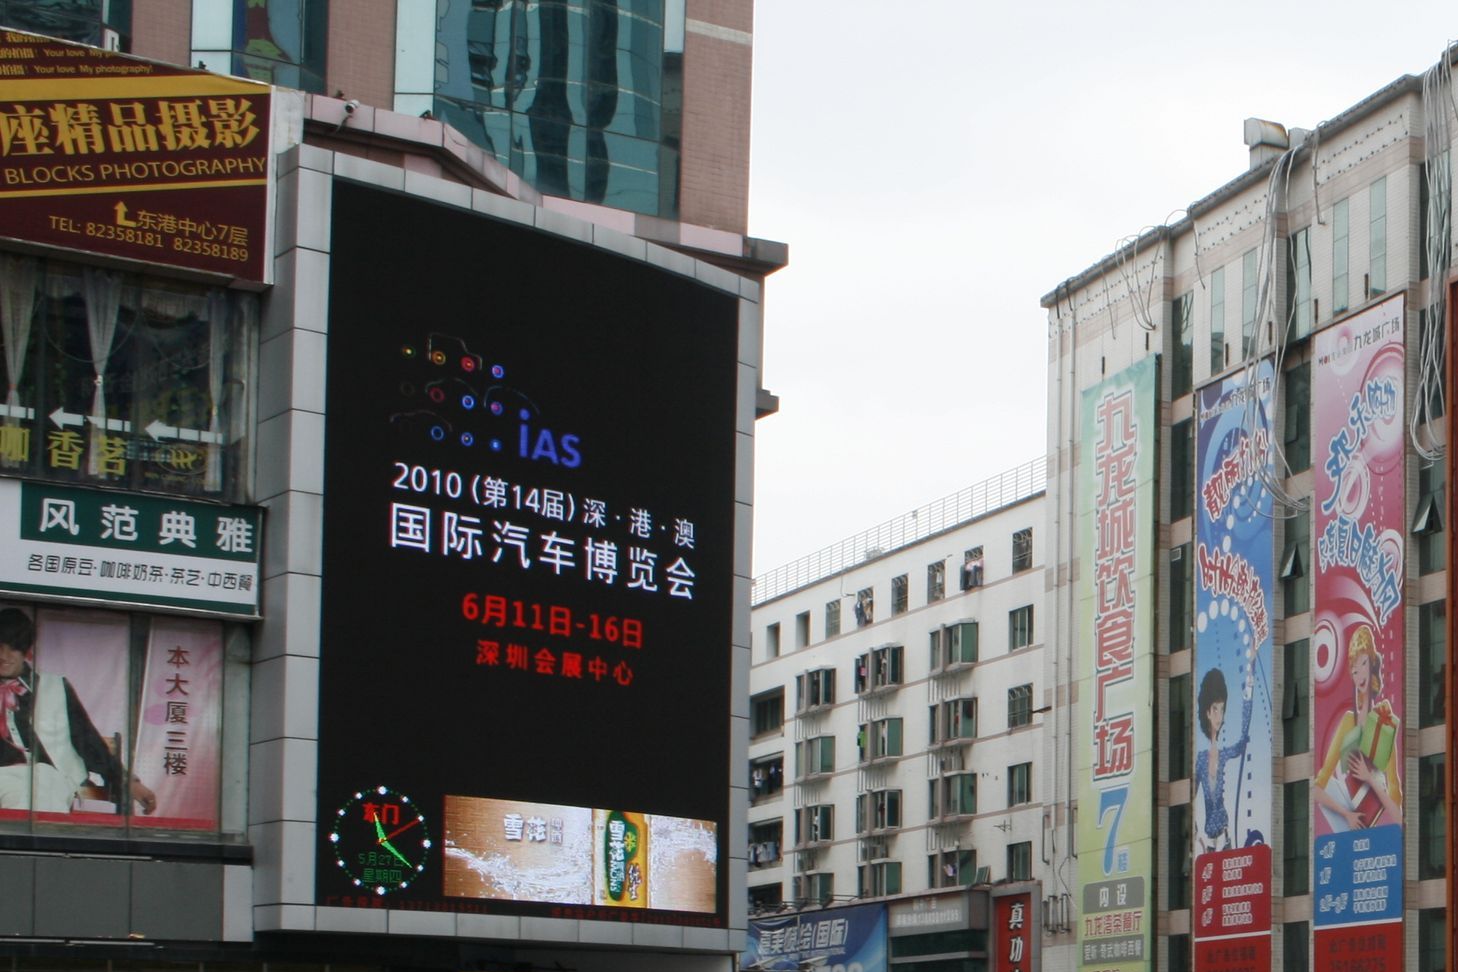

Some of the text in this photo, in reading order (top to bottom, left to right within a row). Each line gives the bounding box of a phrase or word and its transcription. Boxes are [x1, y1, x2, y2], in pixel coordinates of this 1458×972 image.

[5, 156, 267, 185] BLOCKS PHOTOGRAPHY
[86, 220, 164, 248] 82358181
[173, 237, 249, 262] 82358189
[39, 497, 254, 553] 风范典雅
[390, 502, 696, 600] 国际汽车博览会
[163, 645, 191, 776] 本大厦三楼
